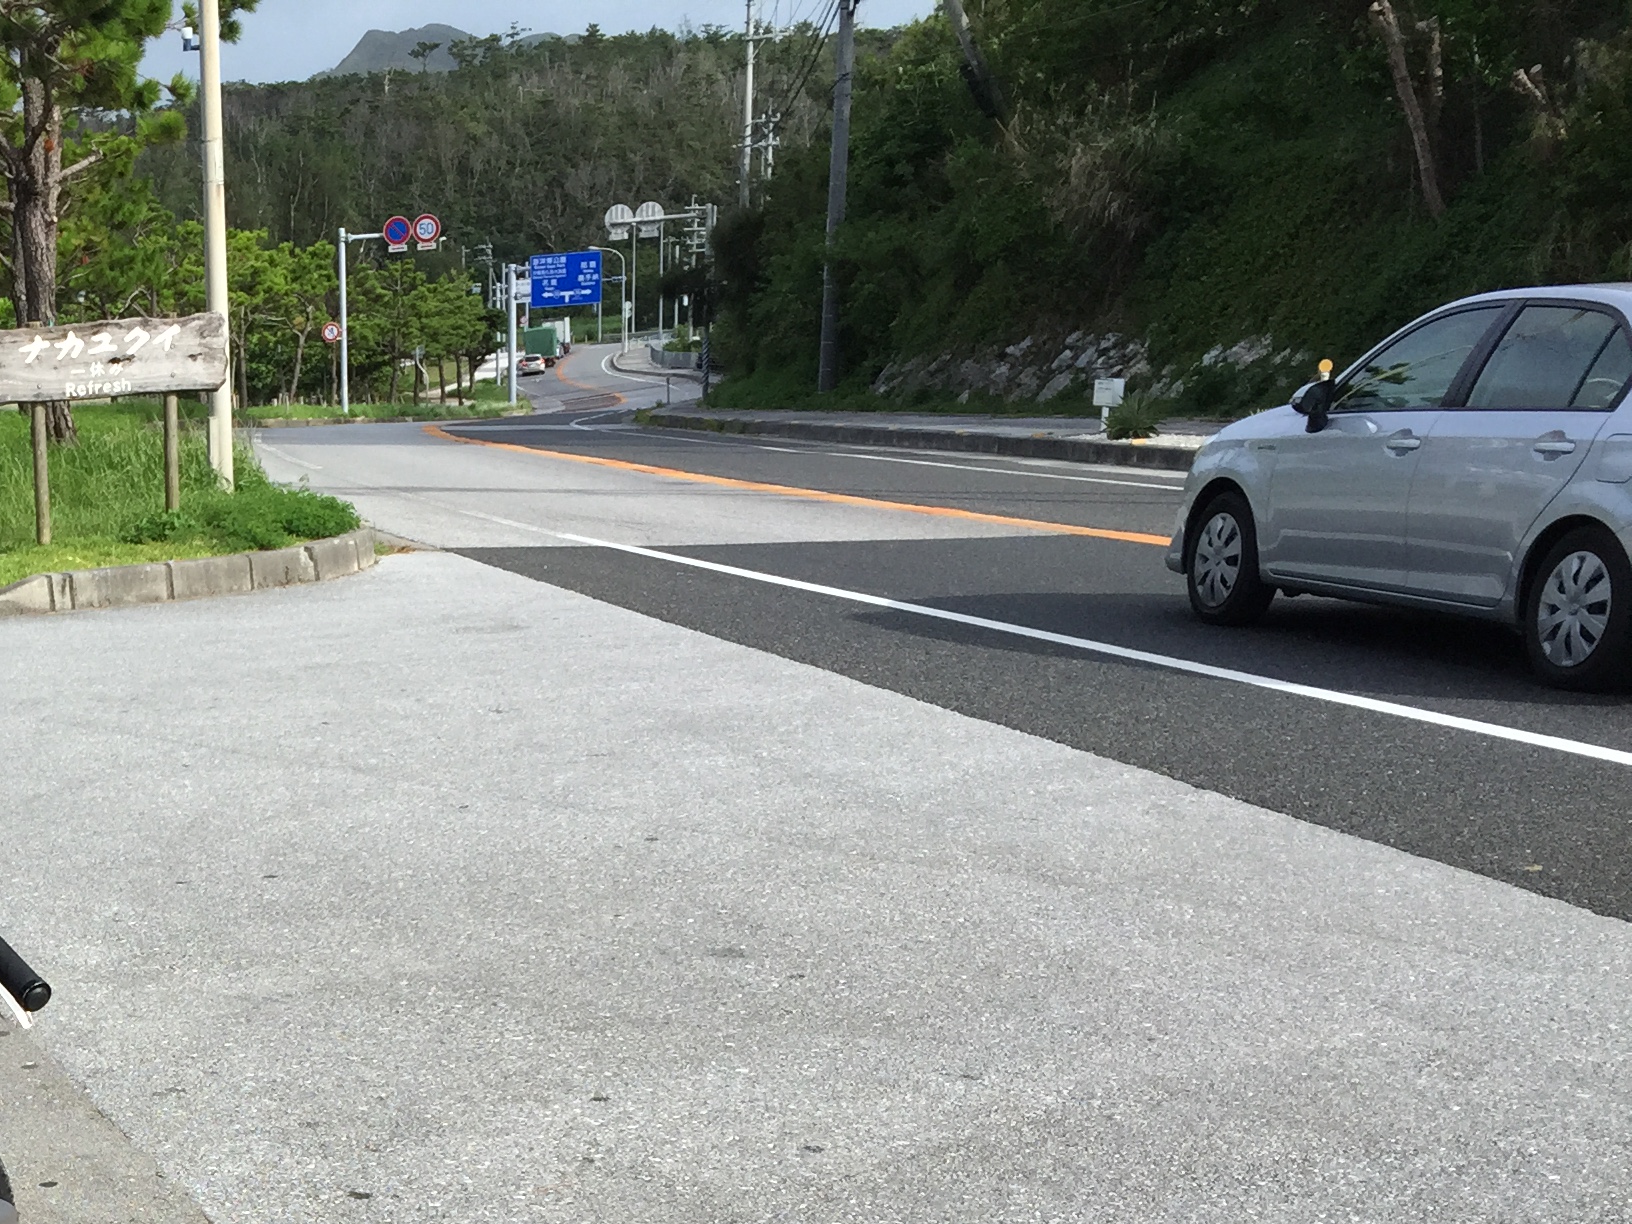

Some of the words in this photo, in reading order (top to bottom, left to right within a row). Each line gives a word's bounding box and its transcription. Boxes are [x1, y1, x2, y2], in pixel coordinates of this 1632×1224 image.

[419, 222, 434, 235] 50
[18, 324, 181, 363] ナカユクイ
[70, 361, 124, 378] 一休み
[65, 379, 132, 397] Refresh
